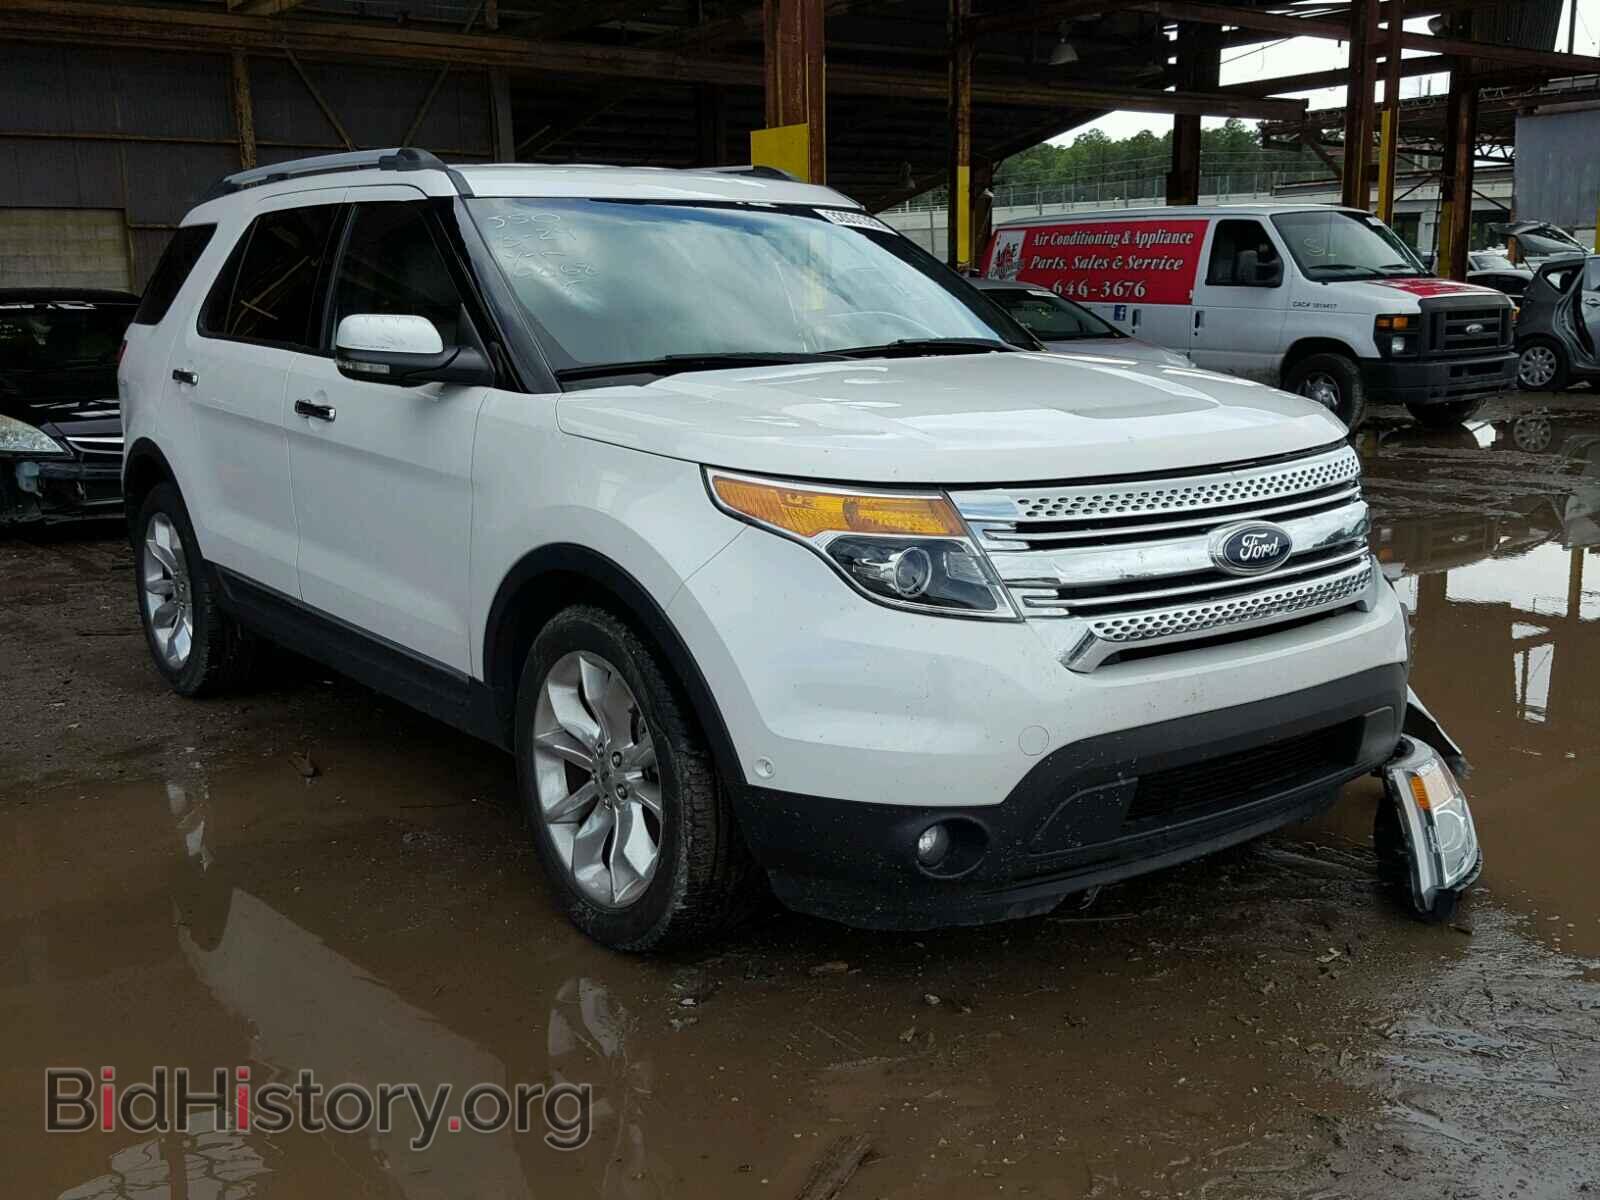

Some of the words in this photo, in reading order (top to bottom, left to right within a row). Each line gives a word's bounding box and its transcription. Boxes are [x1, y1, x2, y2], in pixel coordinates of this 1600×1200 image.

[1032, 232, 1048, 246] Air
[1050, 231, 1119, 248] Conditioning
[1121, 230, 1130, 245] &
[1135, 229, 1194, 249] Appliance
[1072, 255, 1108, 270] Sales
[1112, 255, 1124, 269] &
[1127, 255, 1184, 270] Service
[1240, 533, 1280, 560] Ford
